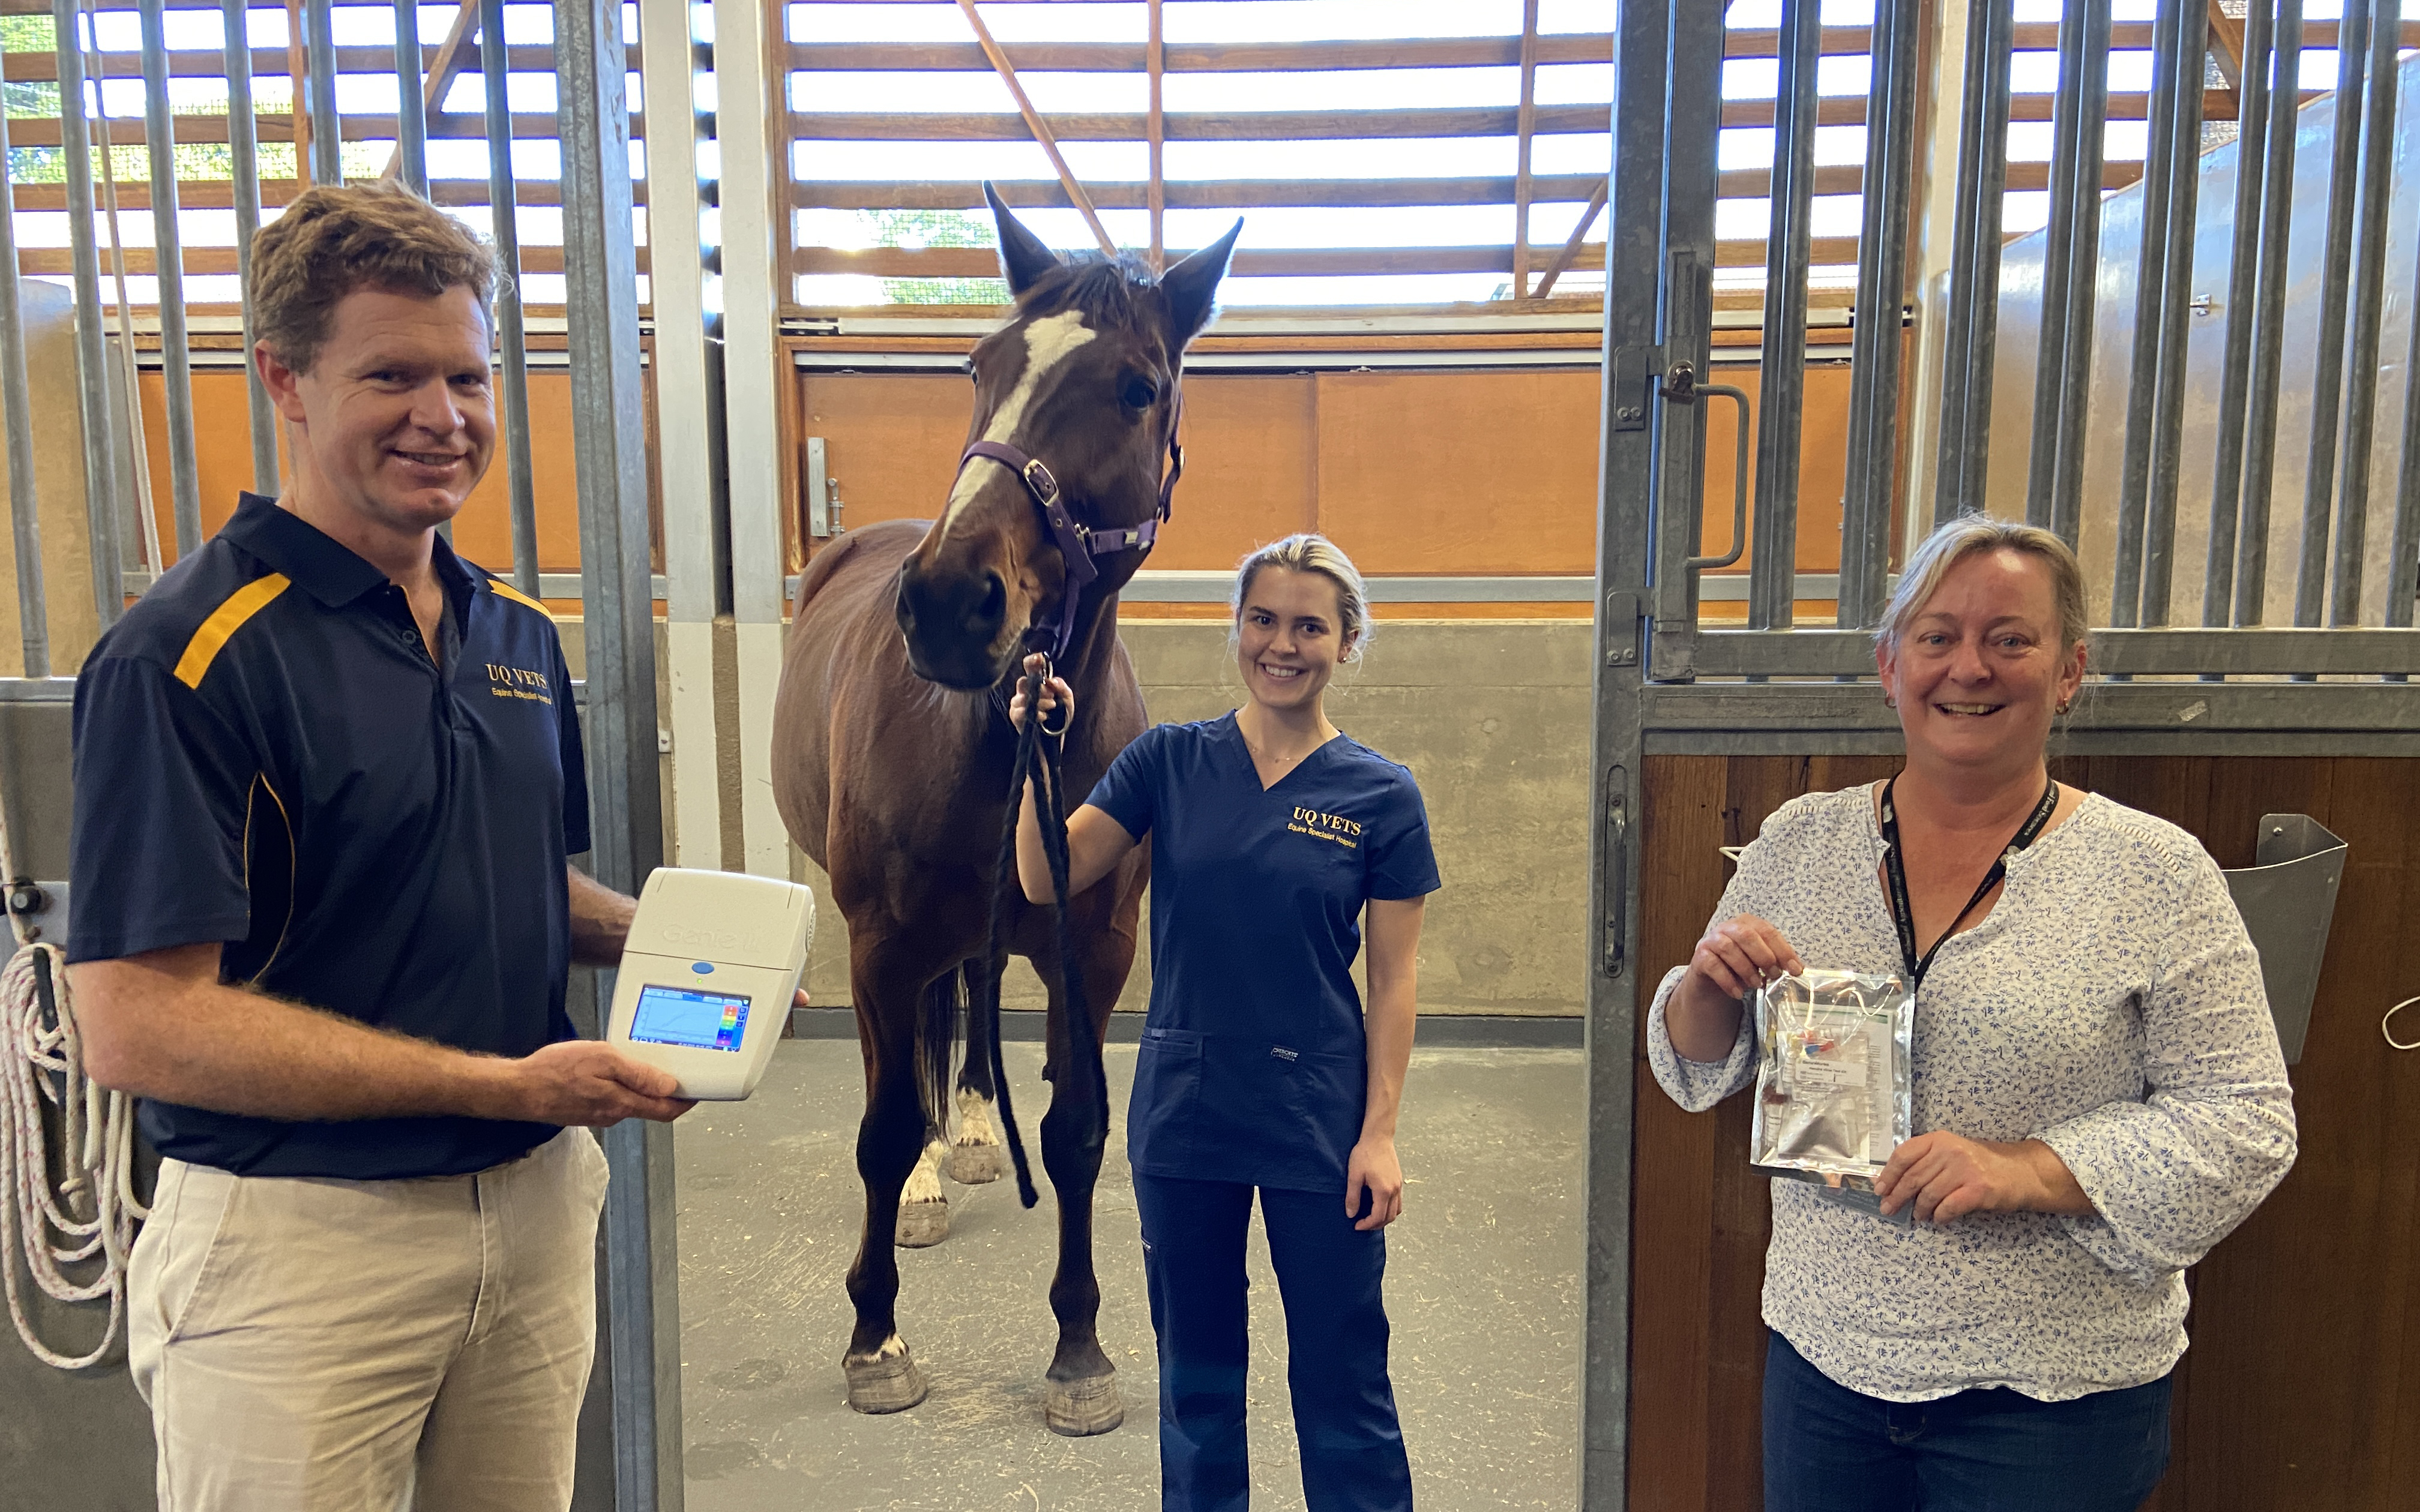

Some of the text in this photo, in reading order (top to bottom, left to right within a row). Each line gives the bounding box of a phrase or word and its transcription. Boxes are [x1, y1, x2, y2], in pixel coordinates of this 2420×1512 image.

[486, 664, 547, 689] UQ VETS
[1293, 806, 1362, 836] UQ VETS
[1287, 823, 1357, 849] Equine Specialist Hospital
